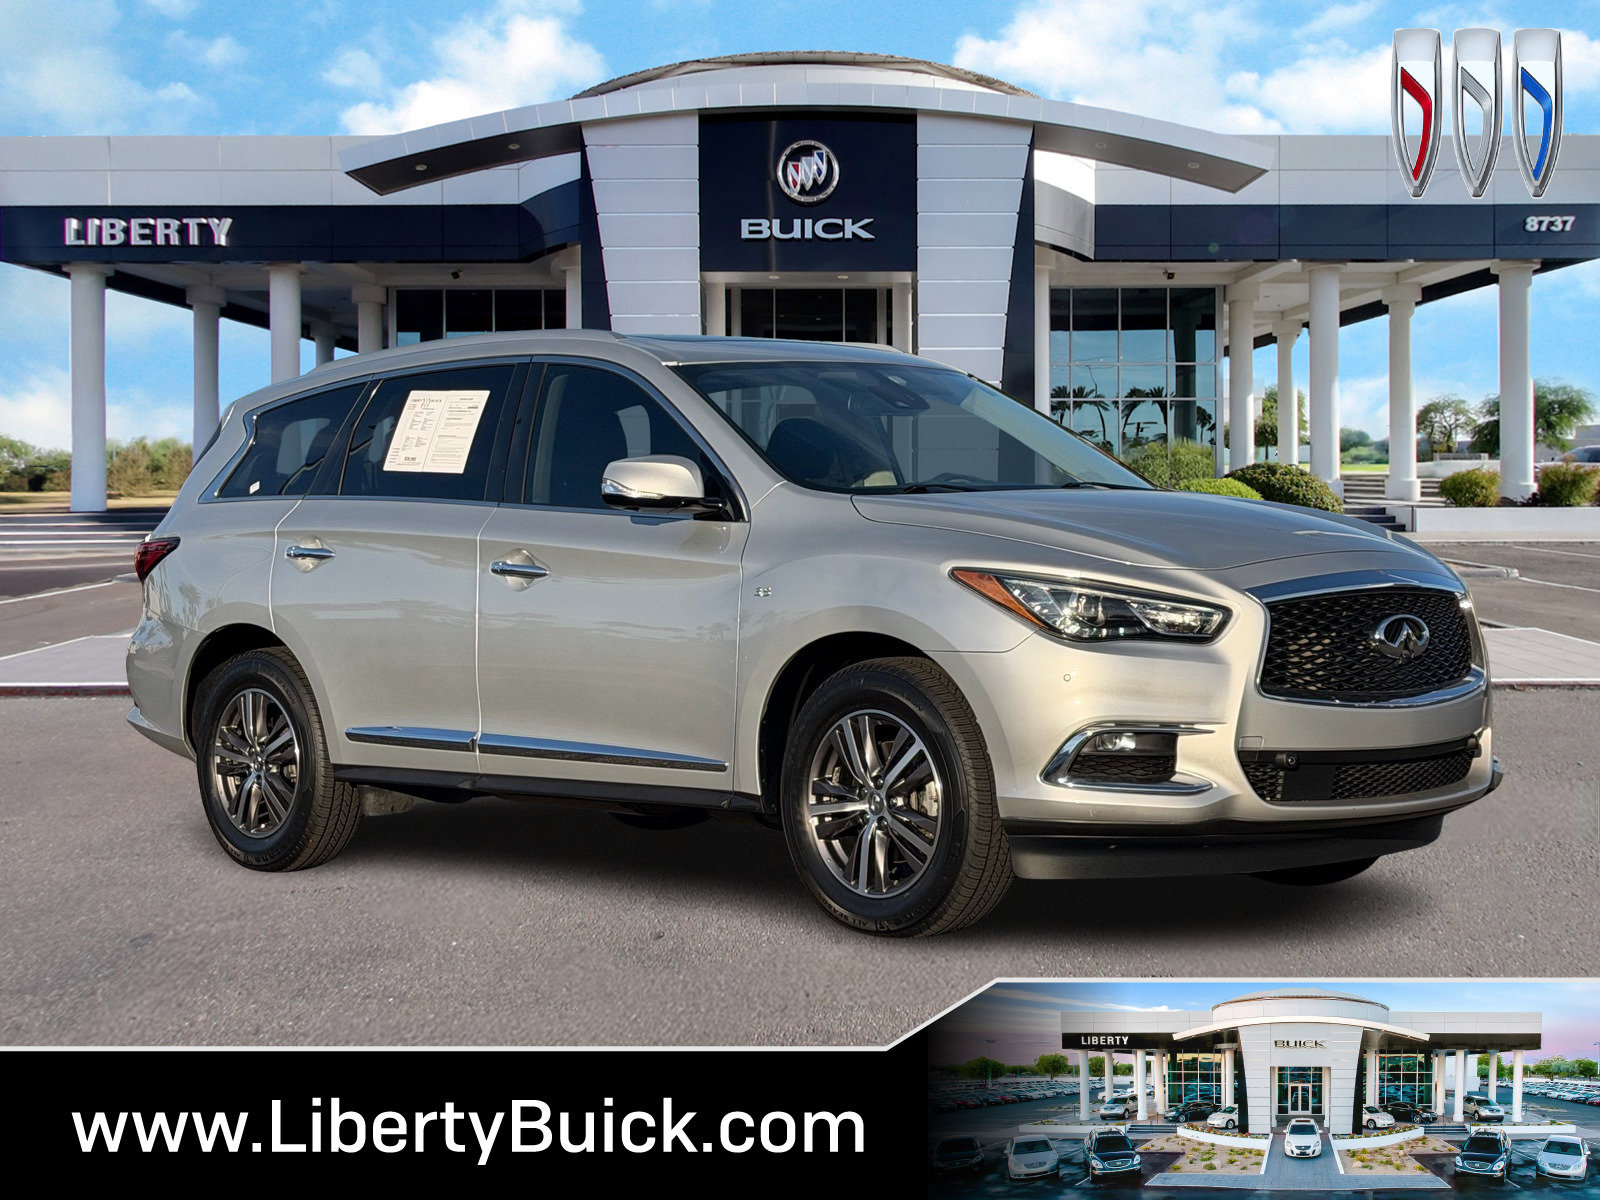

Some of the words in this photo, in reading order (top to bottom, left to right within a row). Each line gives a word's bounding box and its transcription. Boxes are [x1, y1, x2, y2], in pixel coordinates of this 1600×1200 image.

[740, 218, 876, 239] BUICK
[1525, 215, 1576, 231] 8737
[64, 217, 233, 246] LIBERTY
[1081, 1035, 1129, 1046] LIBERTY
[1274, 1039, 1327, 1049] BUICK
